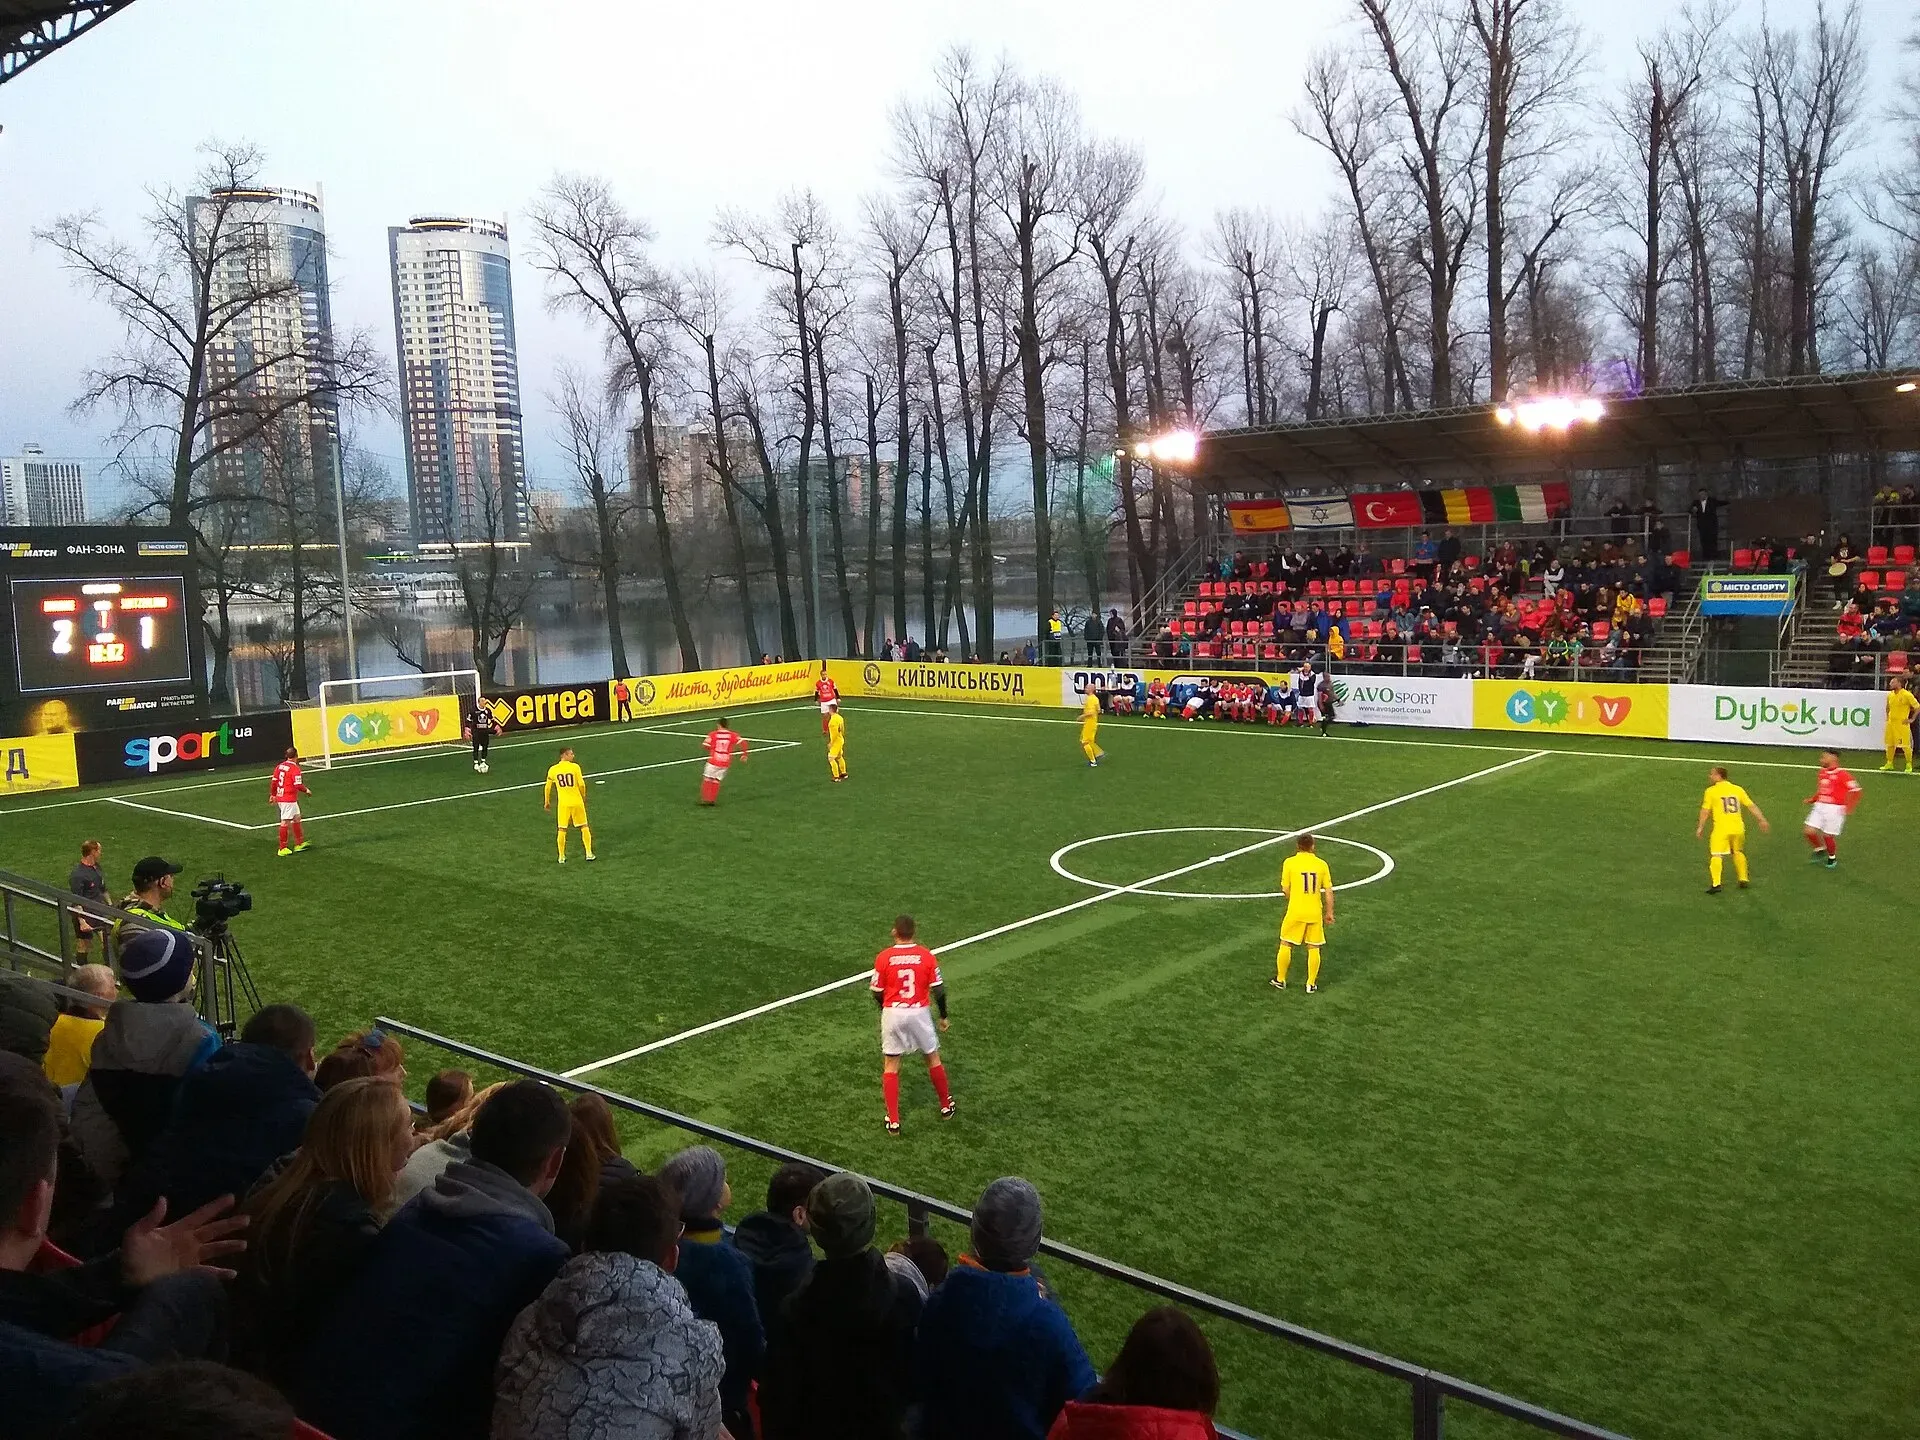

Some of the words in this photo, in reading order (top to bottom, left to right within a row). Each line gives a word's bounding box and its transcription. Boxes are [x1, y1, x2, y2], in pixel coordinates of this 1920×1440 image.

[24, 549, 58, 558] MATCH
[66, 545, 126, 555] ФАН-ЗОНА
[1723, 583, 1750, 591] МІСТО
[1751, 583, 1786, 591] СПОРТУ
[53, 620, 72, 653] 2
[140, 617, 153, 649] 1
[897, 665, 1025, 697] КИЇВМІСЬКБУД
[106, 698, 125, 706] PARI
[129, 701, 158, 710] MATCH
[1358, 705, 1432, 715] www.avosport.com.ua
[1715, 695, 1871, 731] Dybok.ua
[0, 748, 29, 781] Д
[557, 773, 574, 787] 80
[1720, 796, 1740, 814] 19
[1301, 872, 1317, 894] 11
[897, 968, 916, 999] 3
